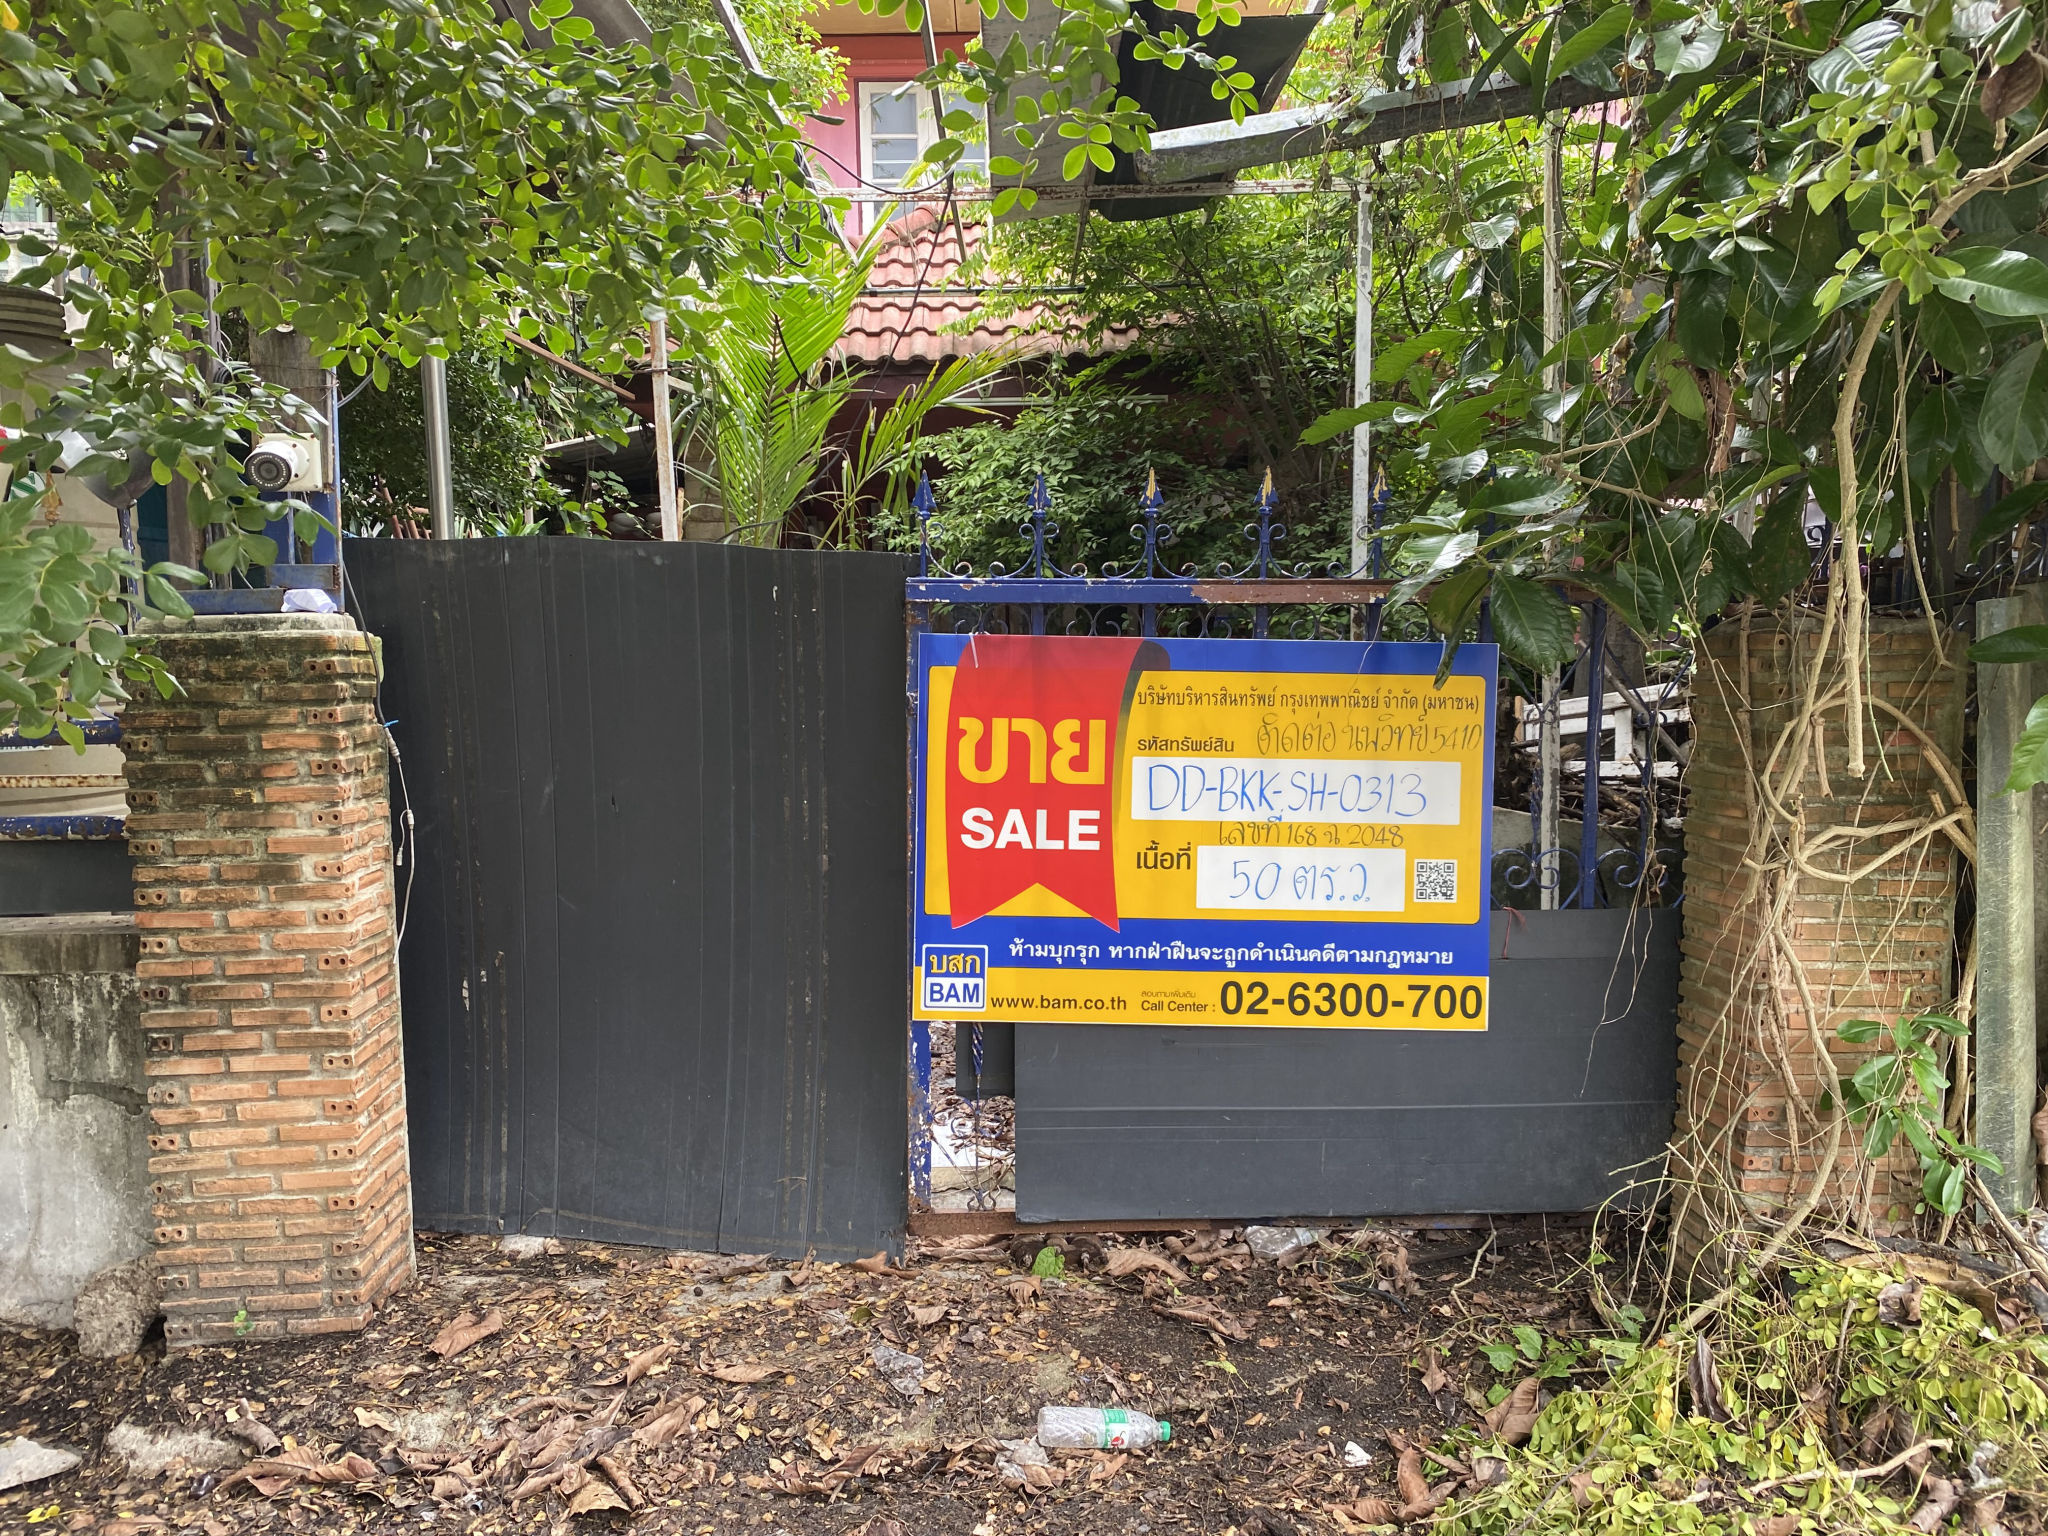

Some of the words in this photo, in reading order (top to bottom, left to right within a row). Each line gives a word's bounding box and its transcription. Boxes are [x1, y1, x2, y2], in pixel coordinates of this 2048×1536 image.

[1138, 685, 1277, 707] บริษัทบริหารสินทรัพย์
[1280, 687, 1379, 714] กรุงเทพพาณิชย์
[1384, 690, 1418, 710] จำกัด
[1423, 694, 1480, 715] (มหาชน)
[958, 716, 1106, 785] ขาย
[1137, 735, 1235, 752] รหัสทรัพย์สิน
[960, 807, 1101, 851] SALE
[1287, 824, 1318, 845] 168
[1346, 824, 1404, 847] 2048
[1136, 840, 1191, 870] เนื้อที่
[1229, 860, 1281, 900] 50
[929, 952, 981, 974] บสก
[1009, 938, 1099, 965] ห้ามบุกรุก
[1109, 942, 1453, 969] หากฝ่าฝืนจะถูกดำเนินคดีตามกฎหมาย
[929, 983, 980, 1003] BAM
[991, 995, 1126, 1011] www.bam.co.th
[1141, 1000, 1164, 1011] Call
[1221, 981, 1482, 1019] 02-6300-700
